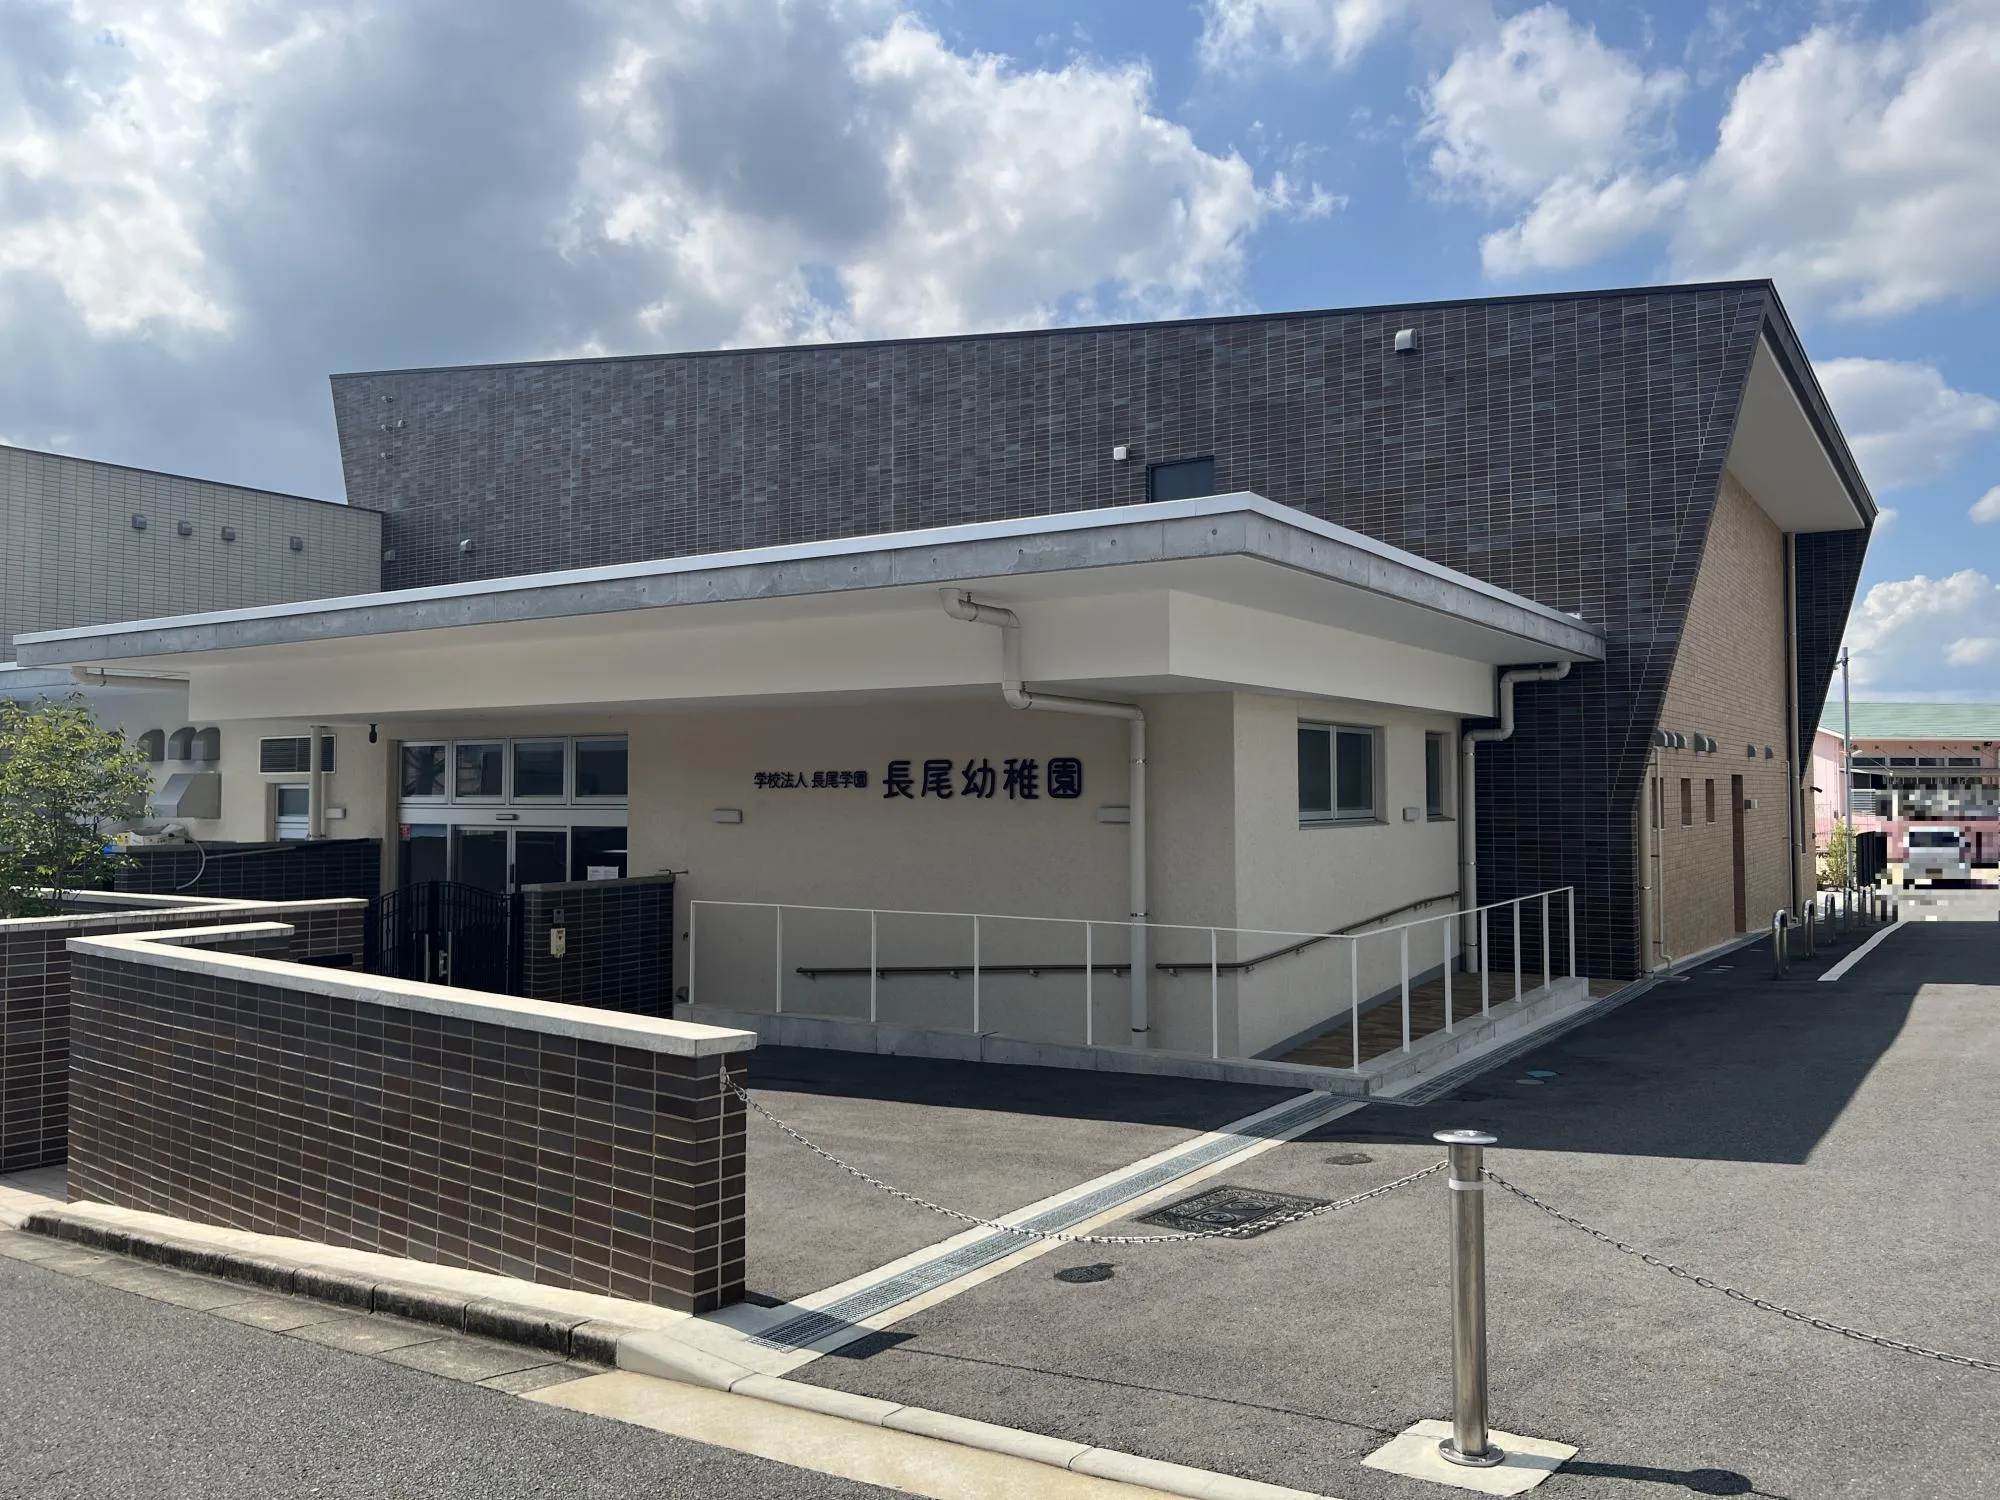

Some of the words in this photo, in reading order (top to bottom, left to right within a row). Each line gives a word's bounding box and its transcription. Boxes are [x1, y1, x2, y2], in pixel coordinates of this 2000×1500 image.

[883, 758, 1082, 800] 長尾幼稚園
